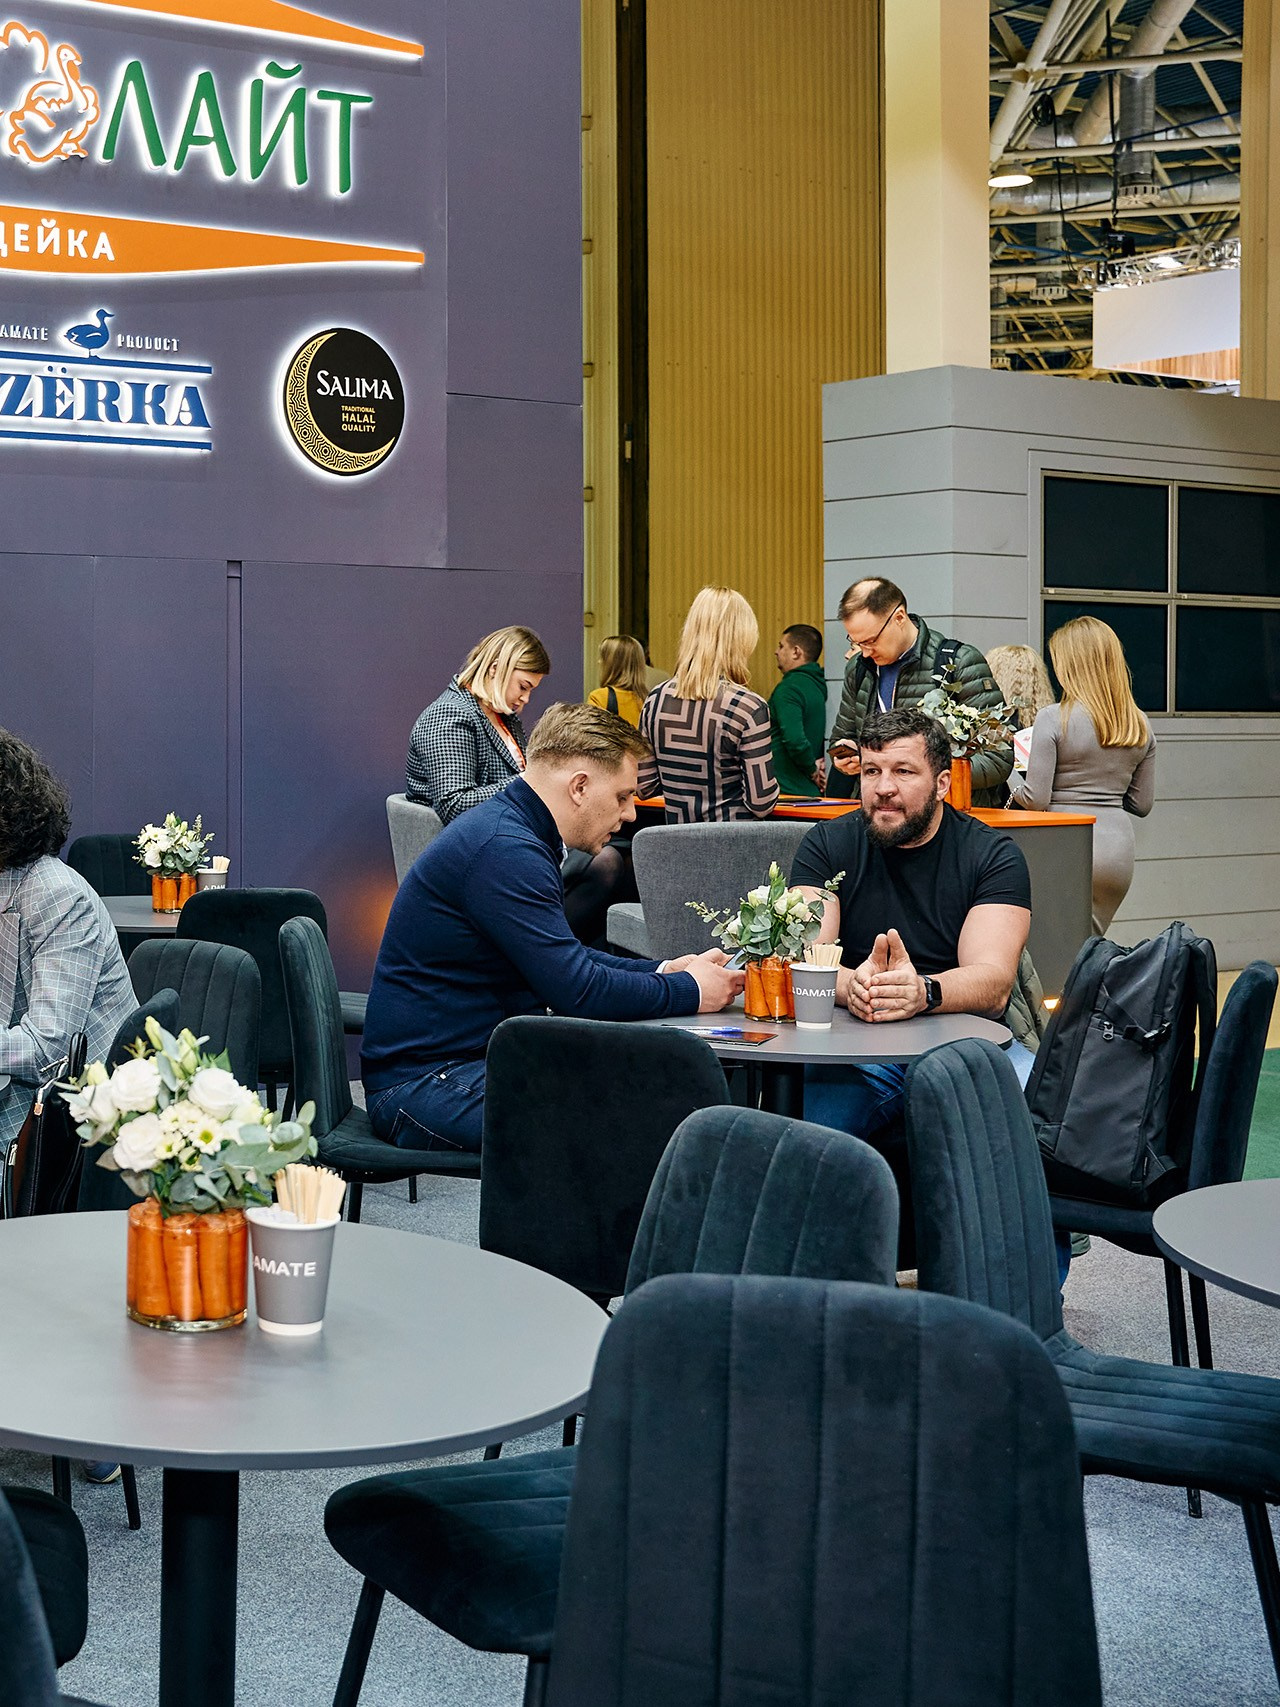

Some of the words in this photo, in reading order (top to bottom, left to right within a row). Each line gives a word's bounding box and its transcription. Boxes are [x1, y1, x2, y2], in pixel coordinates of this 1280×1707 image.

[117, 334, 180, 352] PRODUCT
[341, 405, 376, 414] TRADITIONAL
[341, 412, 376, 424] HALAL
[341, 423, 376, 433] QUALITY
[795, 987, 836, 997] DAMATE
